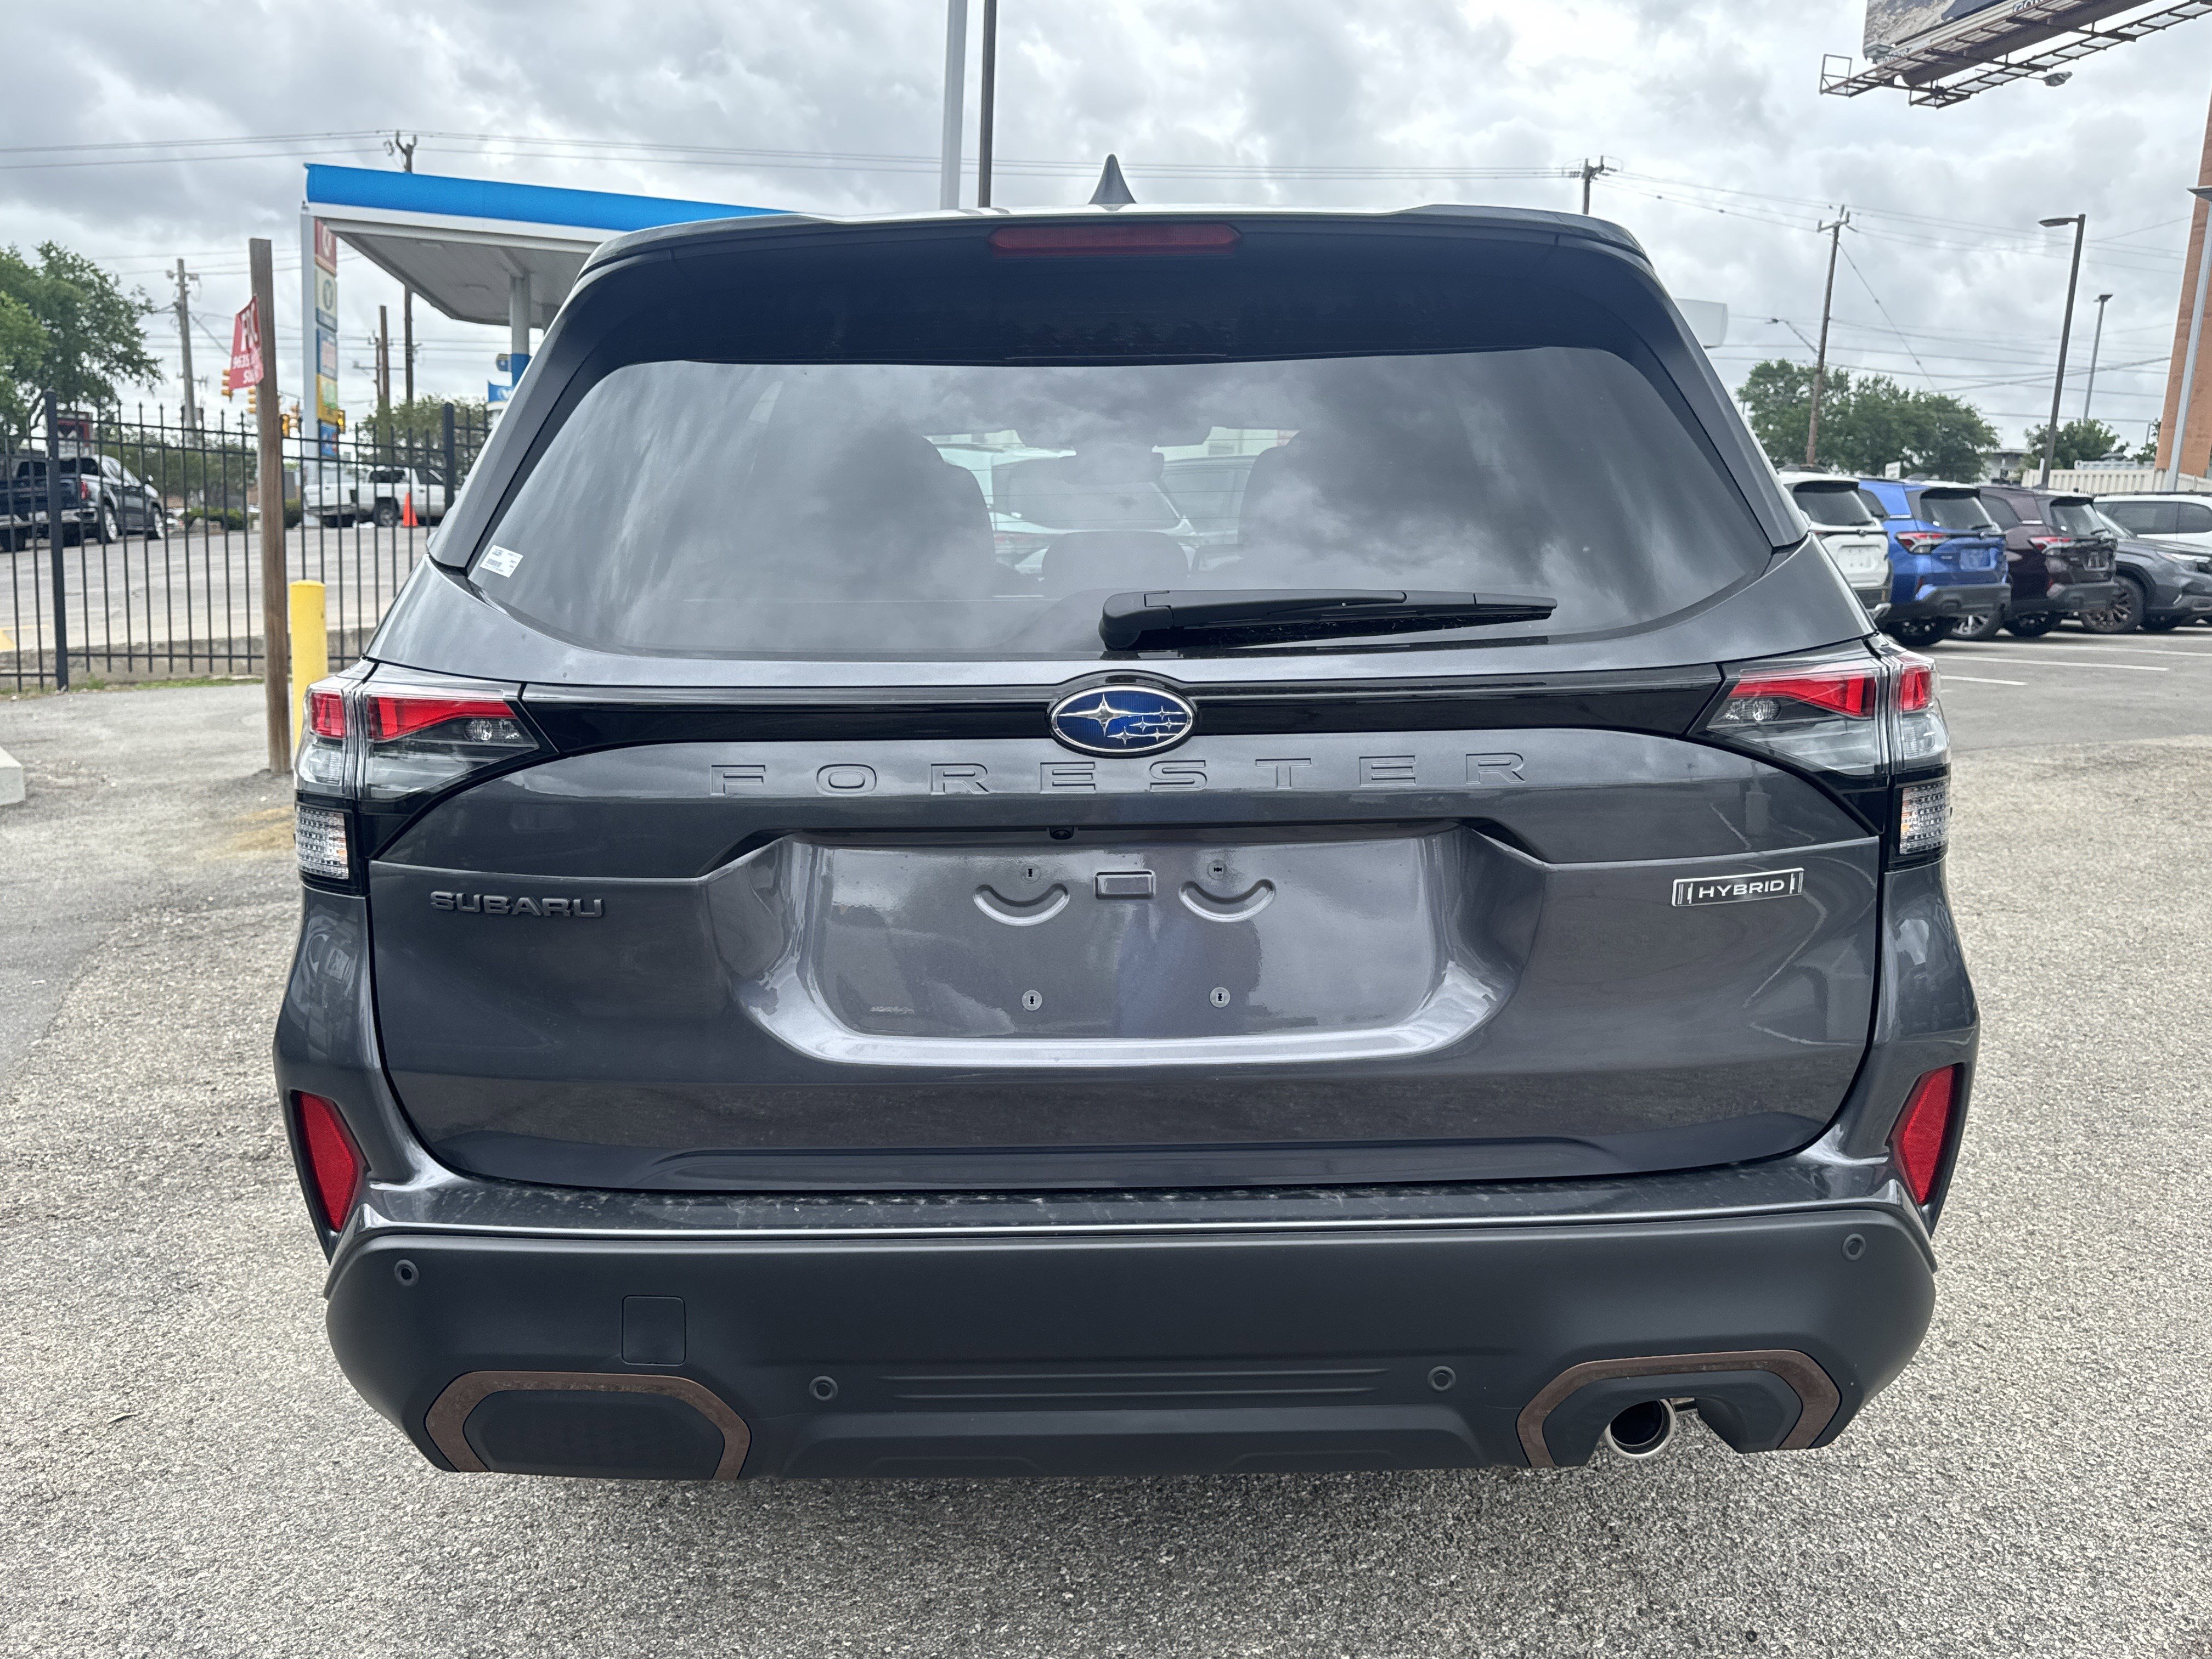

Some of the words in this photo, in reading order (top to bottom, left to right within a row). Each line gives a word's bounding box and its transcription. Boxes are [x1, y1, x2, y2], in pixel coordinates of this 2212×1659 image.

[710, 752, 1526, 797] FORESTER
[1699, 879, 1785, 898] HYBRID
[430, 890, 605, 918] SUBARU
